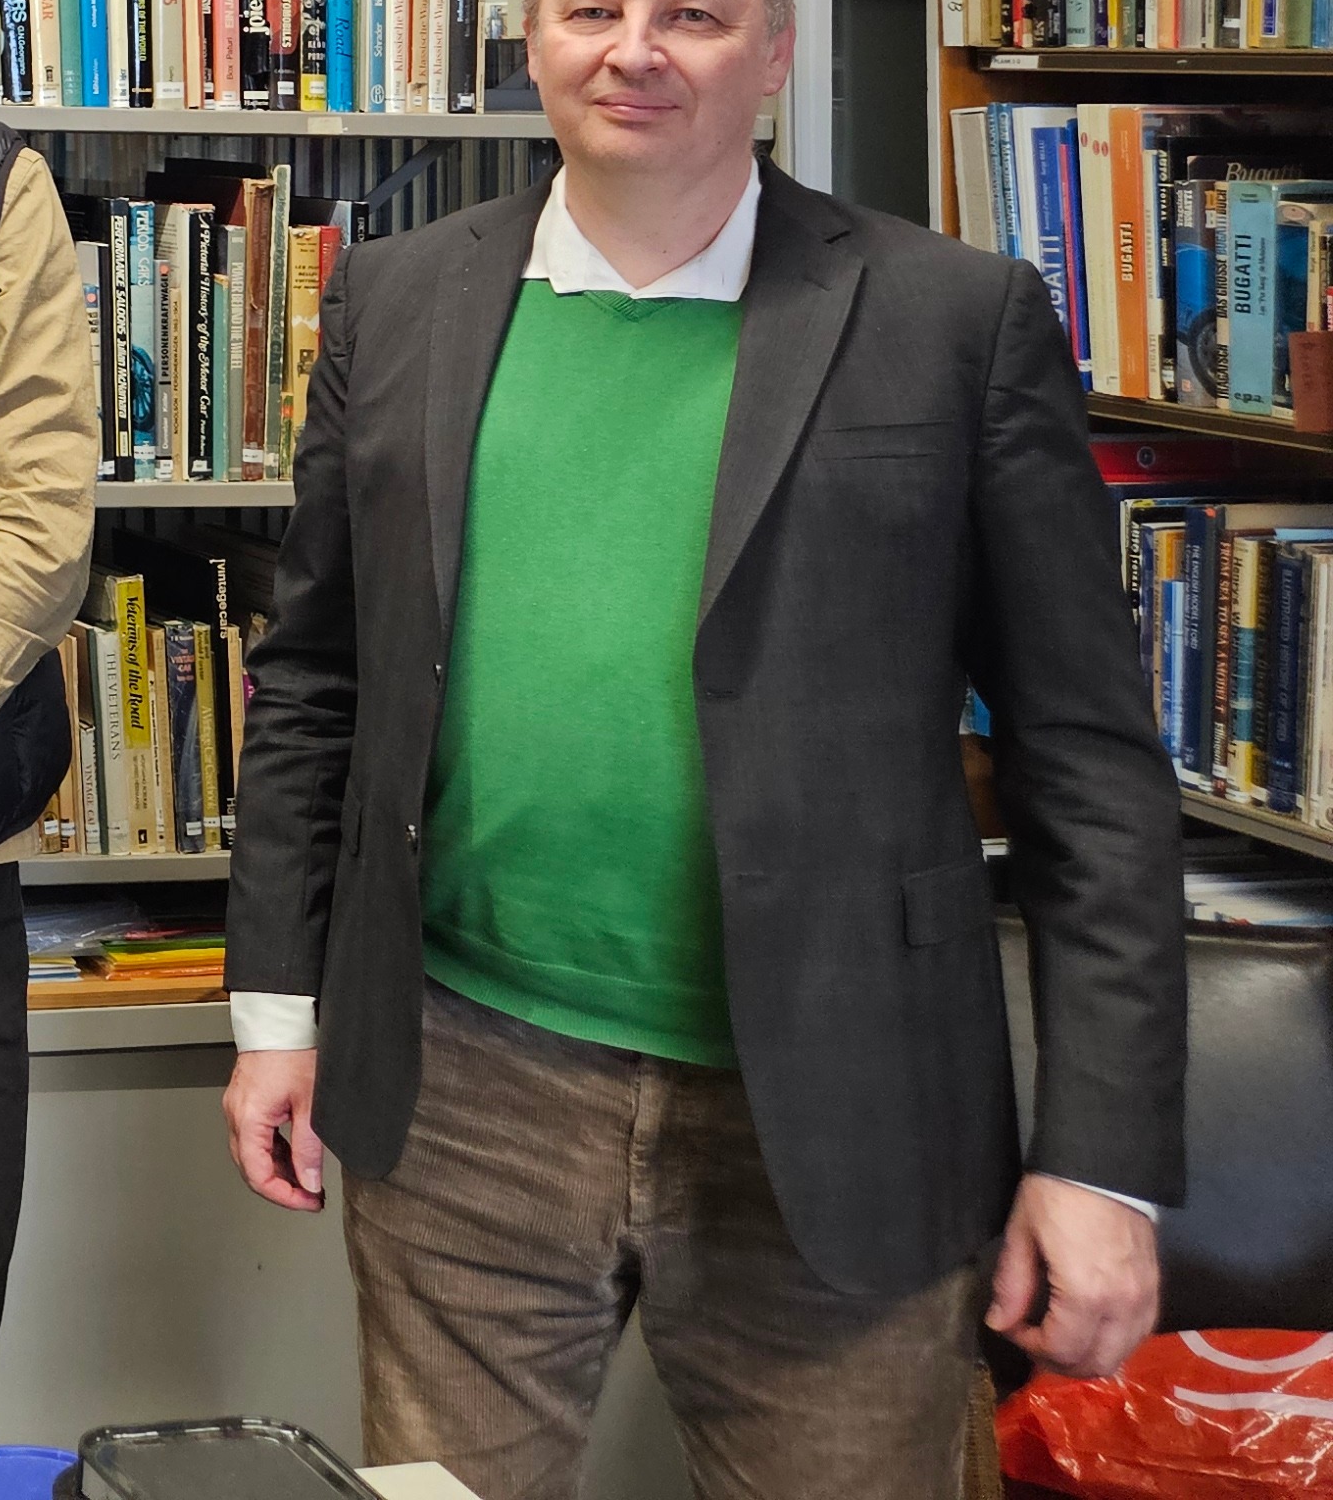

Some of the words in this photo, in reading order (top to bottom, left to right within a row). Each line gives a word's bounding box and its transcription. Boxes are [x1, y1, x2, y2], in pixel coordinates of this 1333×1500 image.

[334, 18, 352, 57] Road
[1225, 162, 1303, 181] Bugatti
[1216, 189, 1227, 219] BUCH
[1120, 221, 1133, 282] BUGATTI
[1217, 257, 1227, 292] GROSSE
[1235, 234, 1252, 315] BUGATTI
[1217, 294, 1227, 319] DAS
[126, 595, 142, 651] Veterans
[126, 652, 141, 667] of
[128, 668, 143, 692] the
[129, 692, 145, 731] Road
